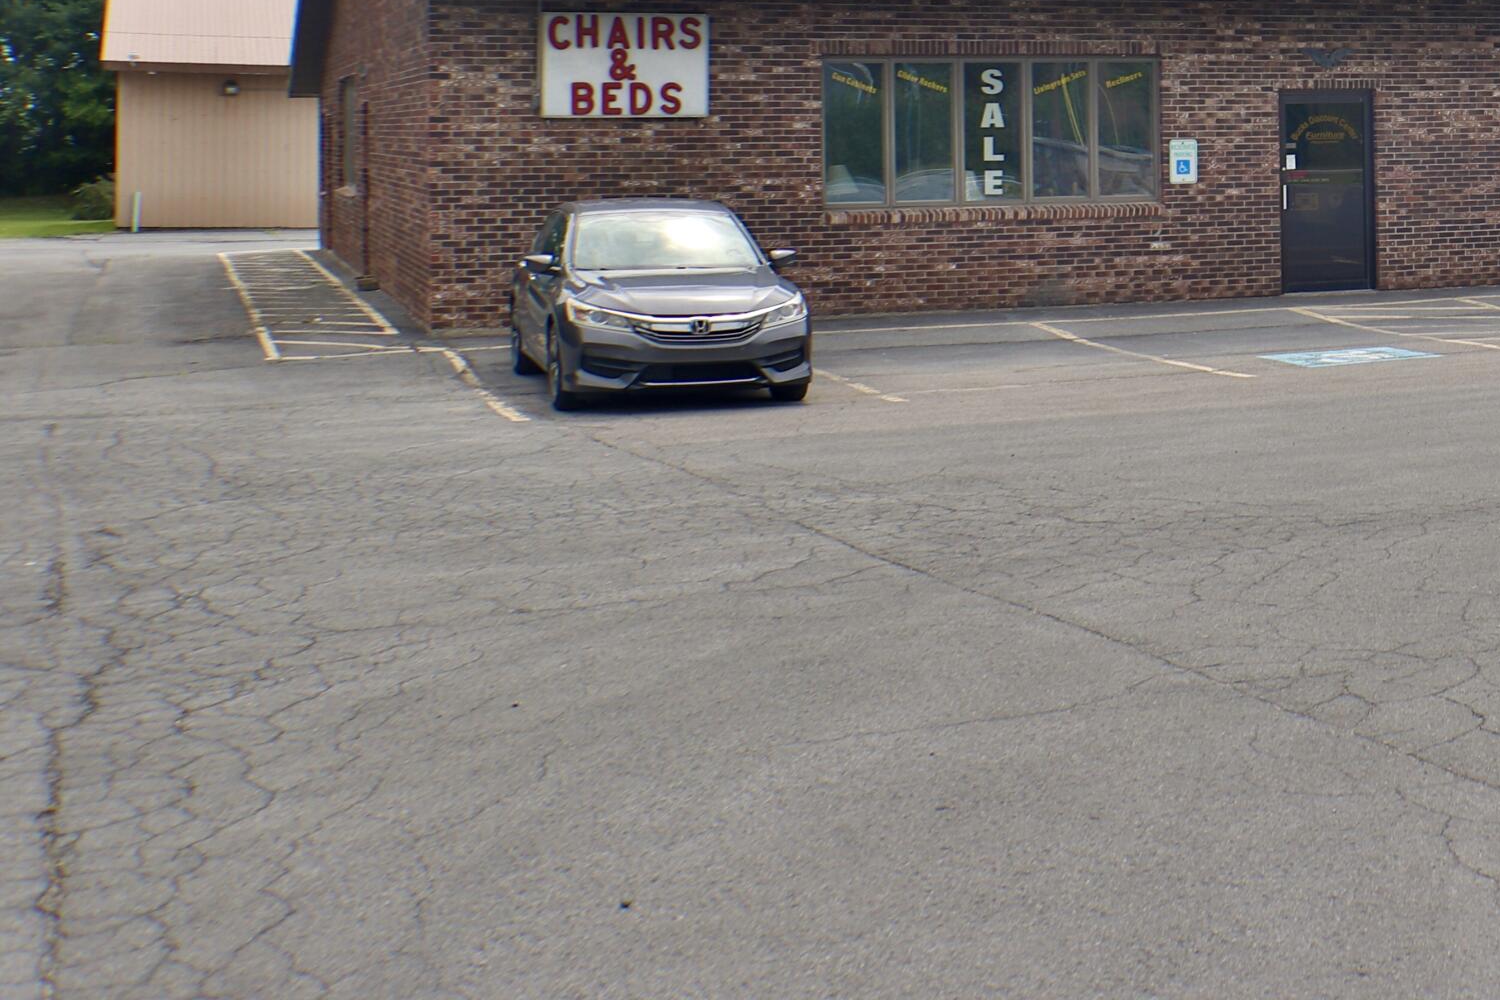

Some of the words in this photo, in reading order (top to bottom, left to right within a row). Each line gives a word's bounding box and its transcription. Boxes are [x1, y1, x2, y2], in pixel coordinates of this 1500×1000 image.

[547, 14, 701, 50] CHAIRS
[609, 48, 636, 81] &
[571, 82, 683, 115] BEDS
[980, 69, 1005, 195] SALE
